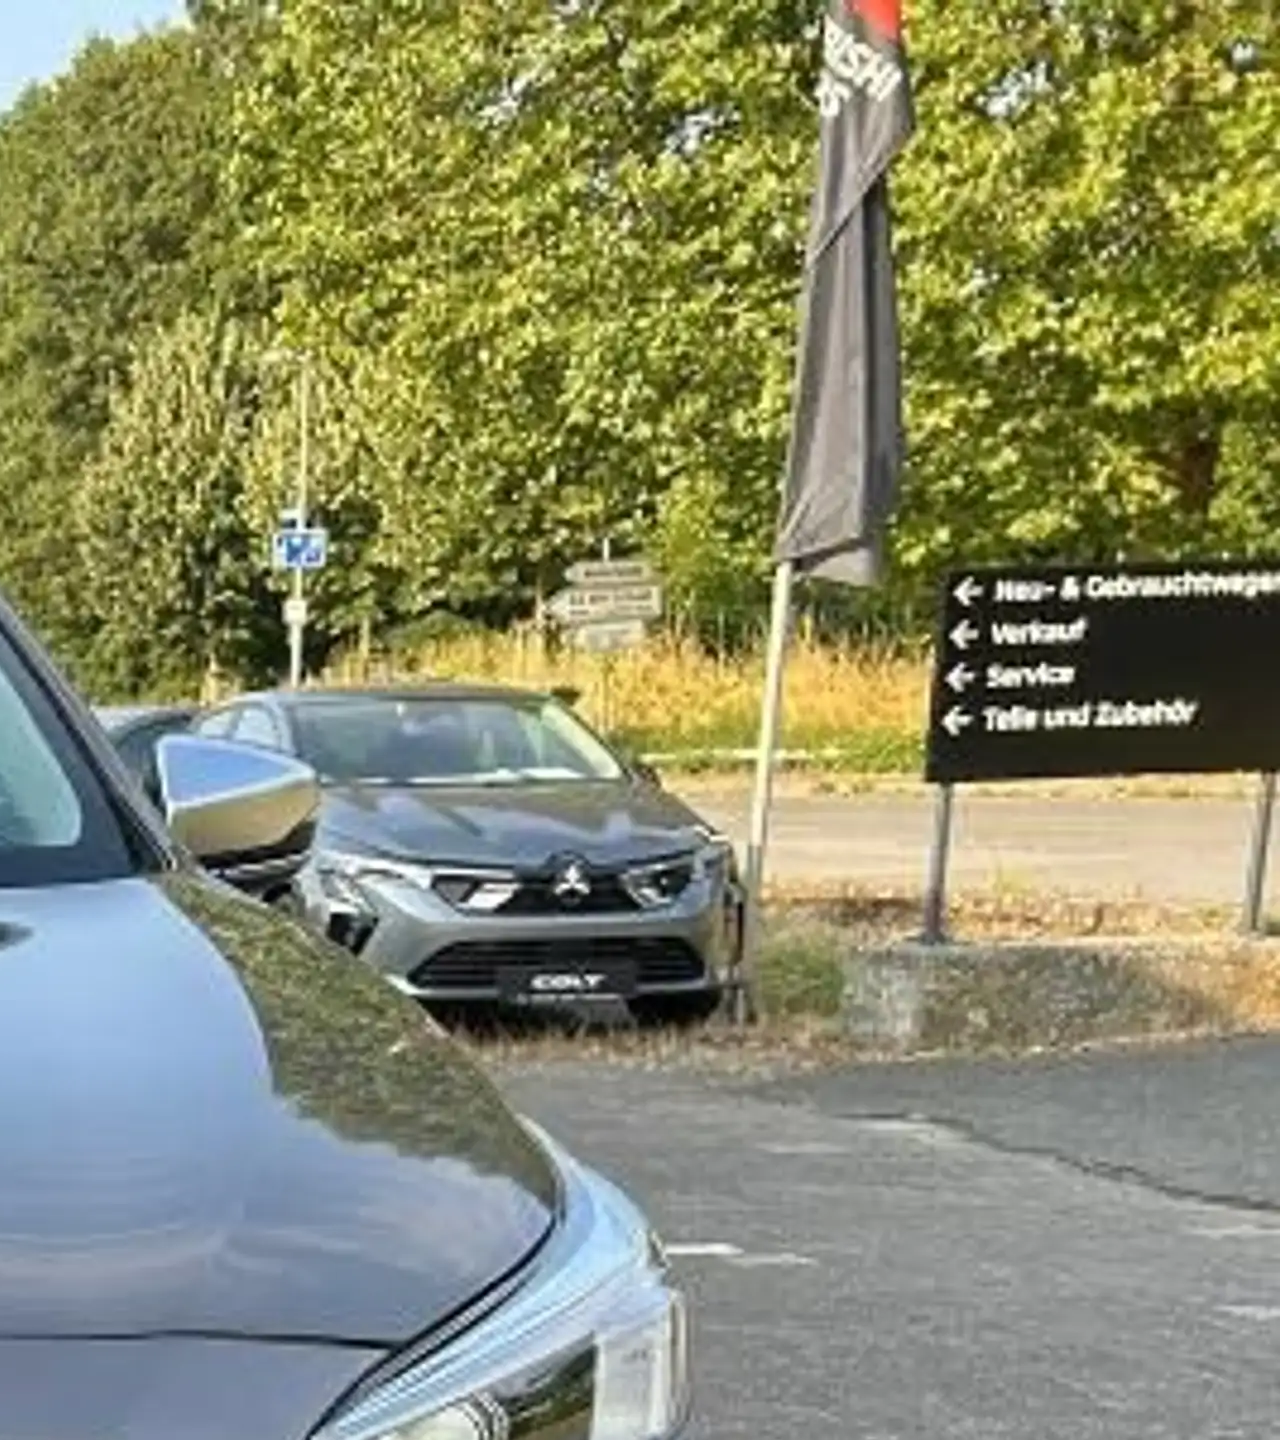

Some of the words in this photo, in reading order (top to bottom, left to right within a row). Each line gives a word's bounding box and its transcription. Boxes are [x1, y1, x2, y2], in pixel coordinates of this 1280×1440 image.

[1059, 575, 1081, 600] &
[990, 615, 1088, 645] Verkauf
[986, 662, 1076, 688] Service
[982, 704, 1037, 732] Teile
[1043, 701, 1090, 730] und
[1093, 697, 1199, 728] Zubehör
